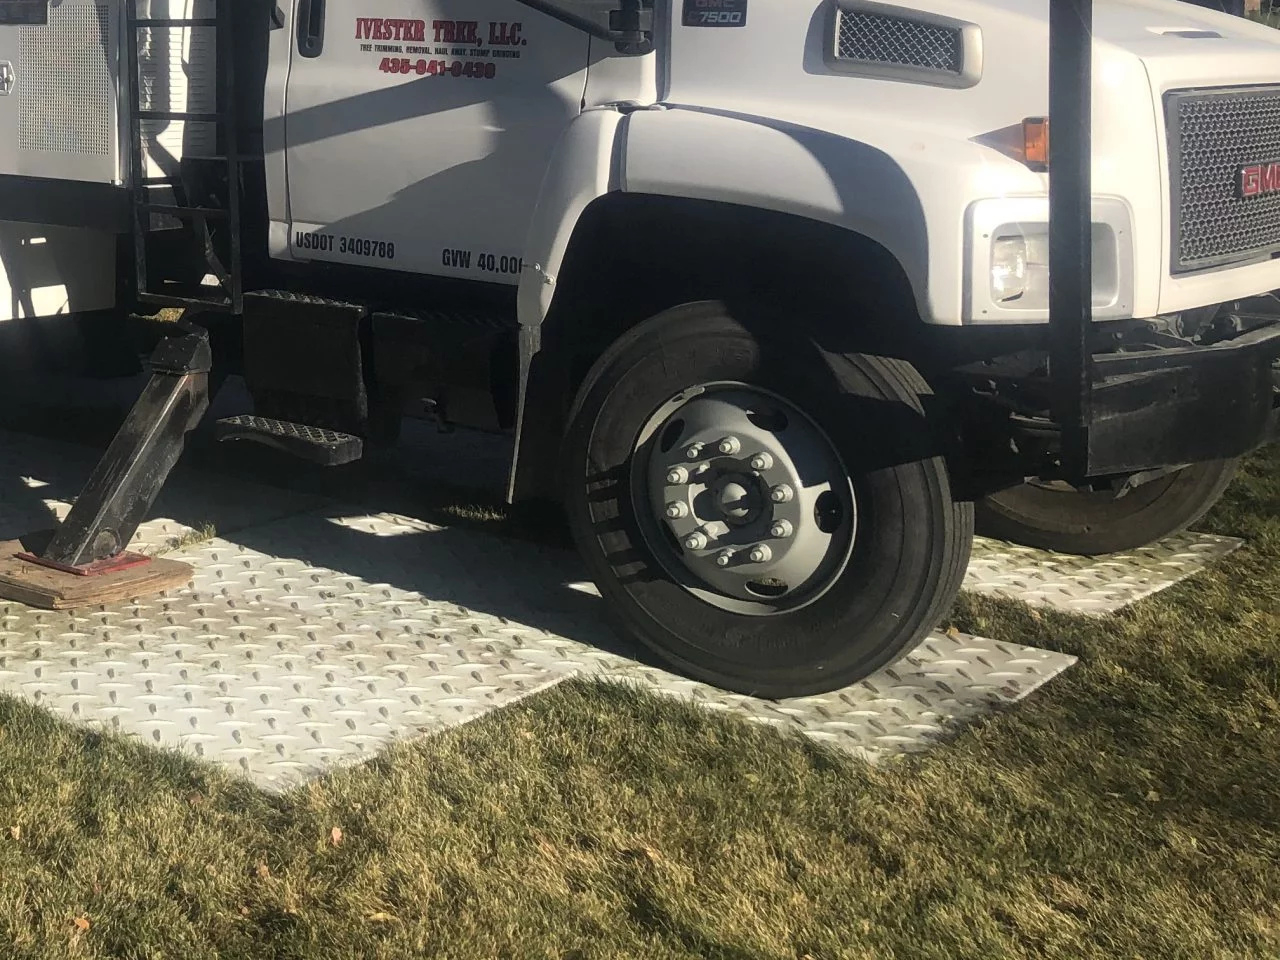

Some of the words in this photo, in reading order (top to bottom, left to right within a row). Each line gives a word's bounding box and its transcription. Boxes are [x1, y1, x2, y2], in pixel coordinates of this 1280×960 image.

[355, 17, 425, 42] IVESTER
[433, 20, 482, 47] TREE,
[488, 22, 527, 46] LLC.
[360, 44, 373, 52] TREE
[296, 231, 335, 251] USDOT
[442, 248, 471, 269] GVW
